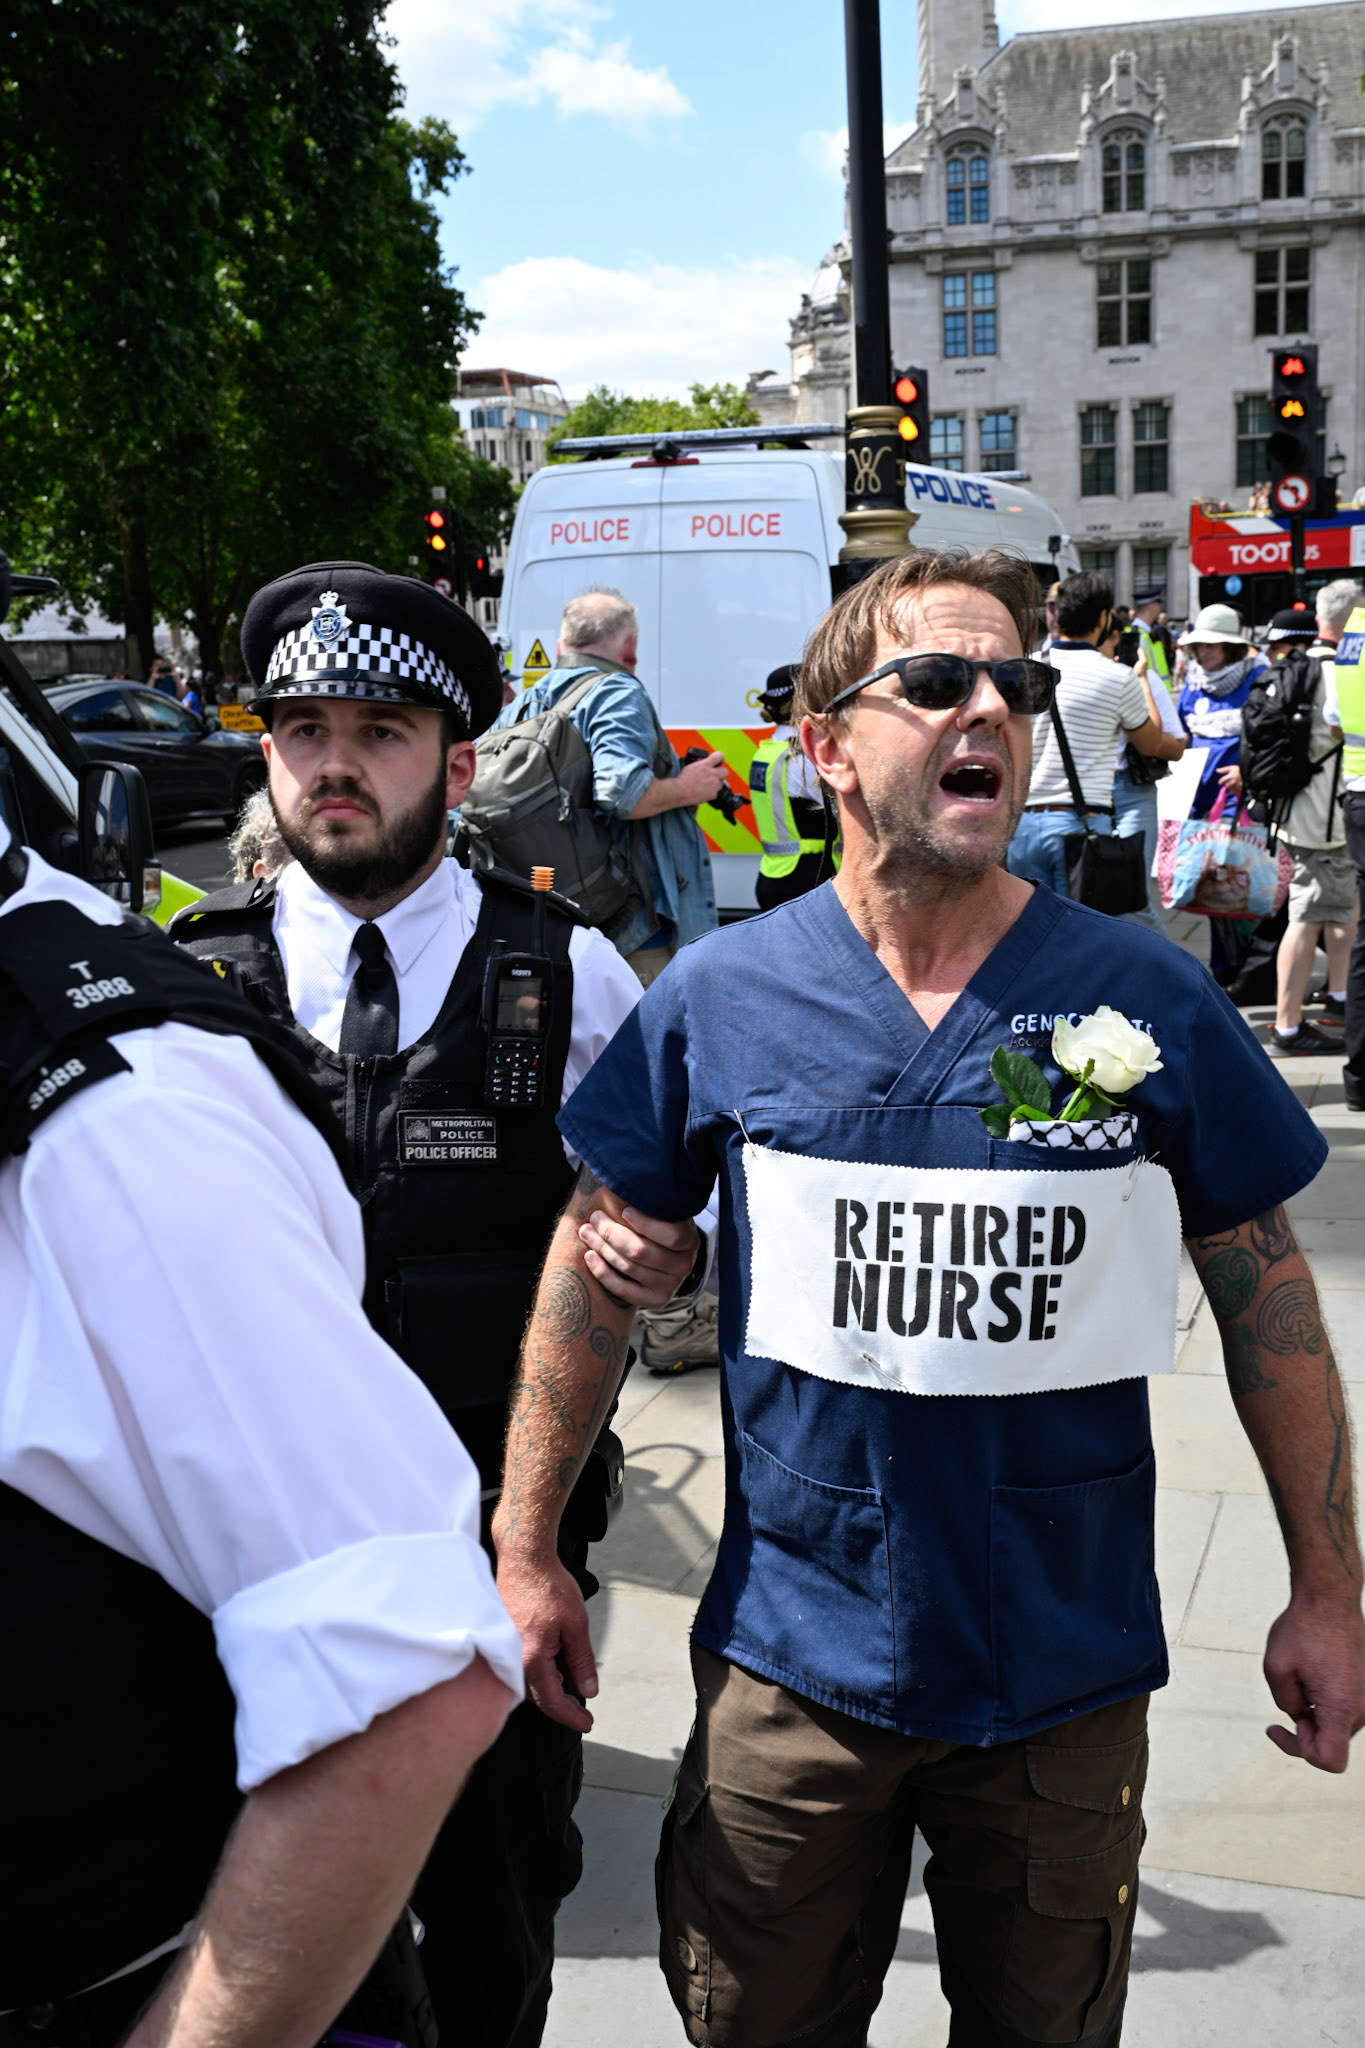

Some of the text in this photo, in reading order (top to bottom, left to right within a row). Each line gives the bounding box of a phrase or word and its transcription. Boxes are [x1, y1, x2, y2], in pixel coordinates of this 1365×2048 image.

[907, 471, 996, 510] POLICE
[551, 518, 630, 545] POLICE
[691, 513, 781, 538] POLICE
[69, 960, 93, 980] T
[65, 976, 136, 1009] 3988
[29, 1058, 87, 1110] 3988
[431, 1120, 493, 1128] METROPOLITAN
[440, 1130, 485, 1140] POLICE
[406, 1146, 497, 1159] POLICE OFFICER
[834, 1199, 1086, 1267] RETIRED
[833, 1260, 1062, 1342] NURSE
